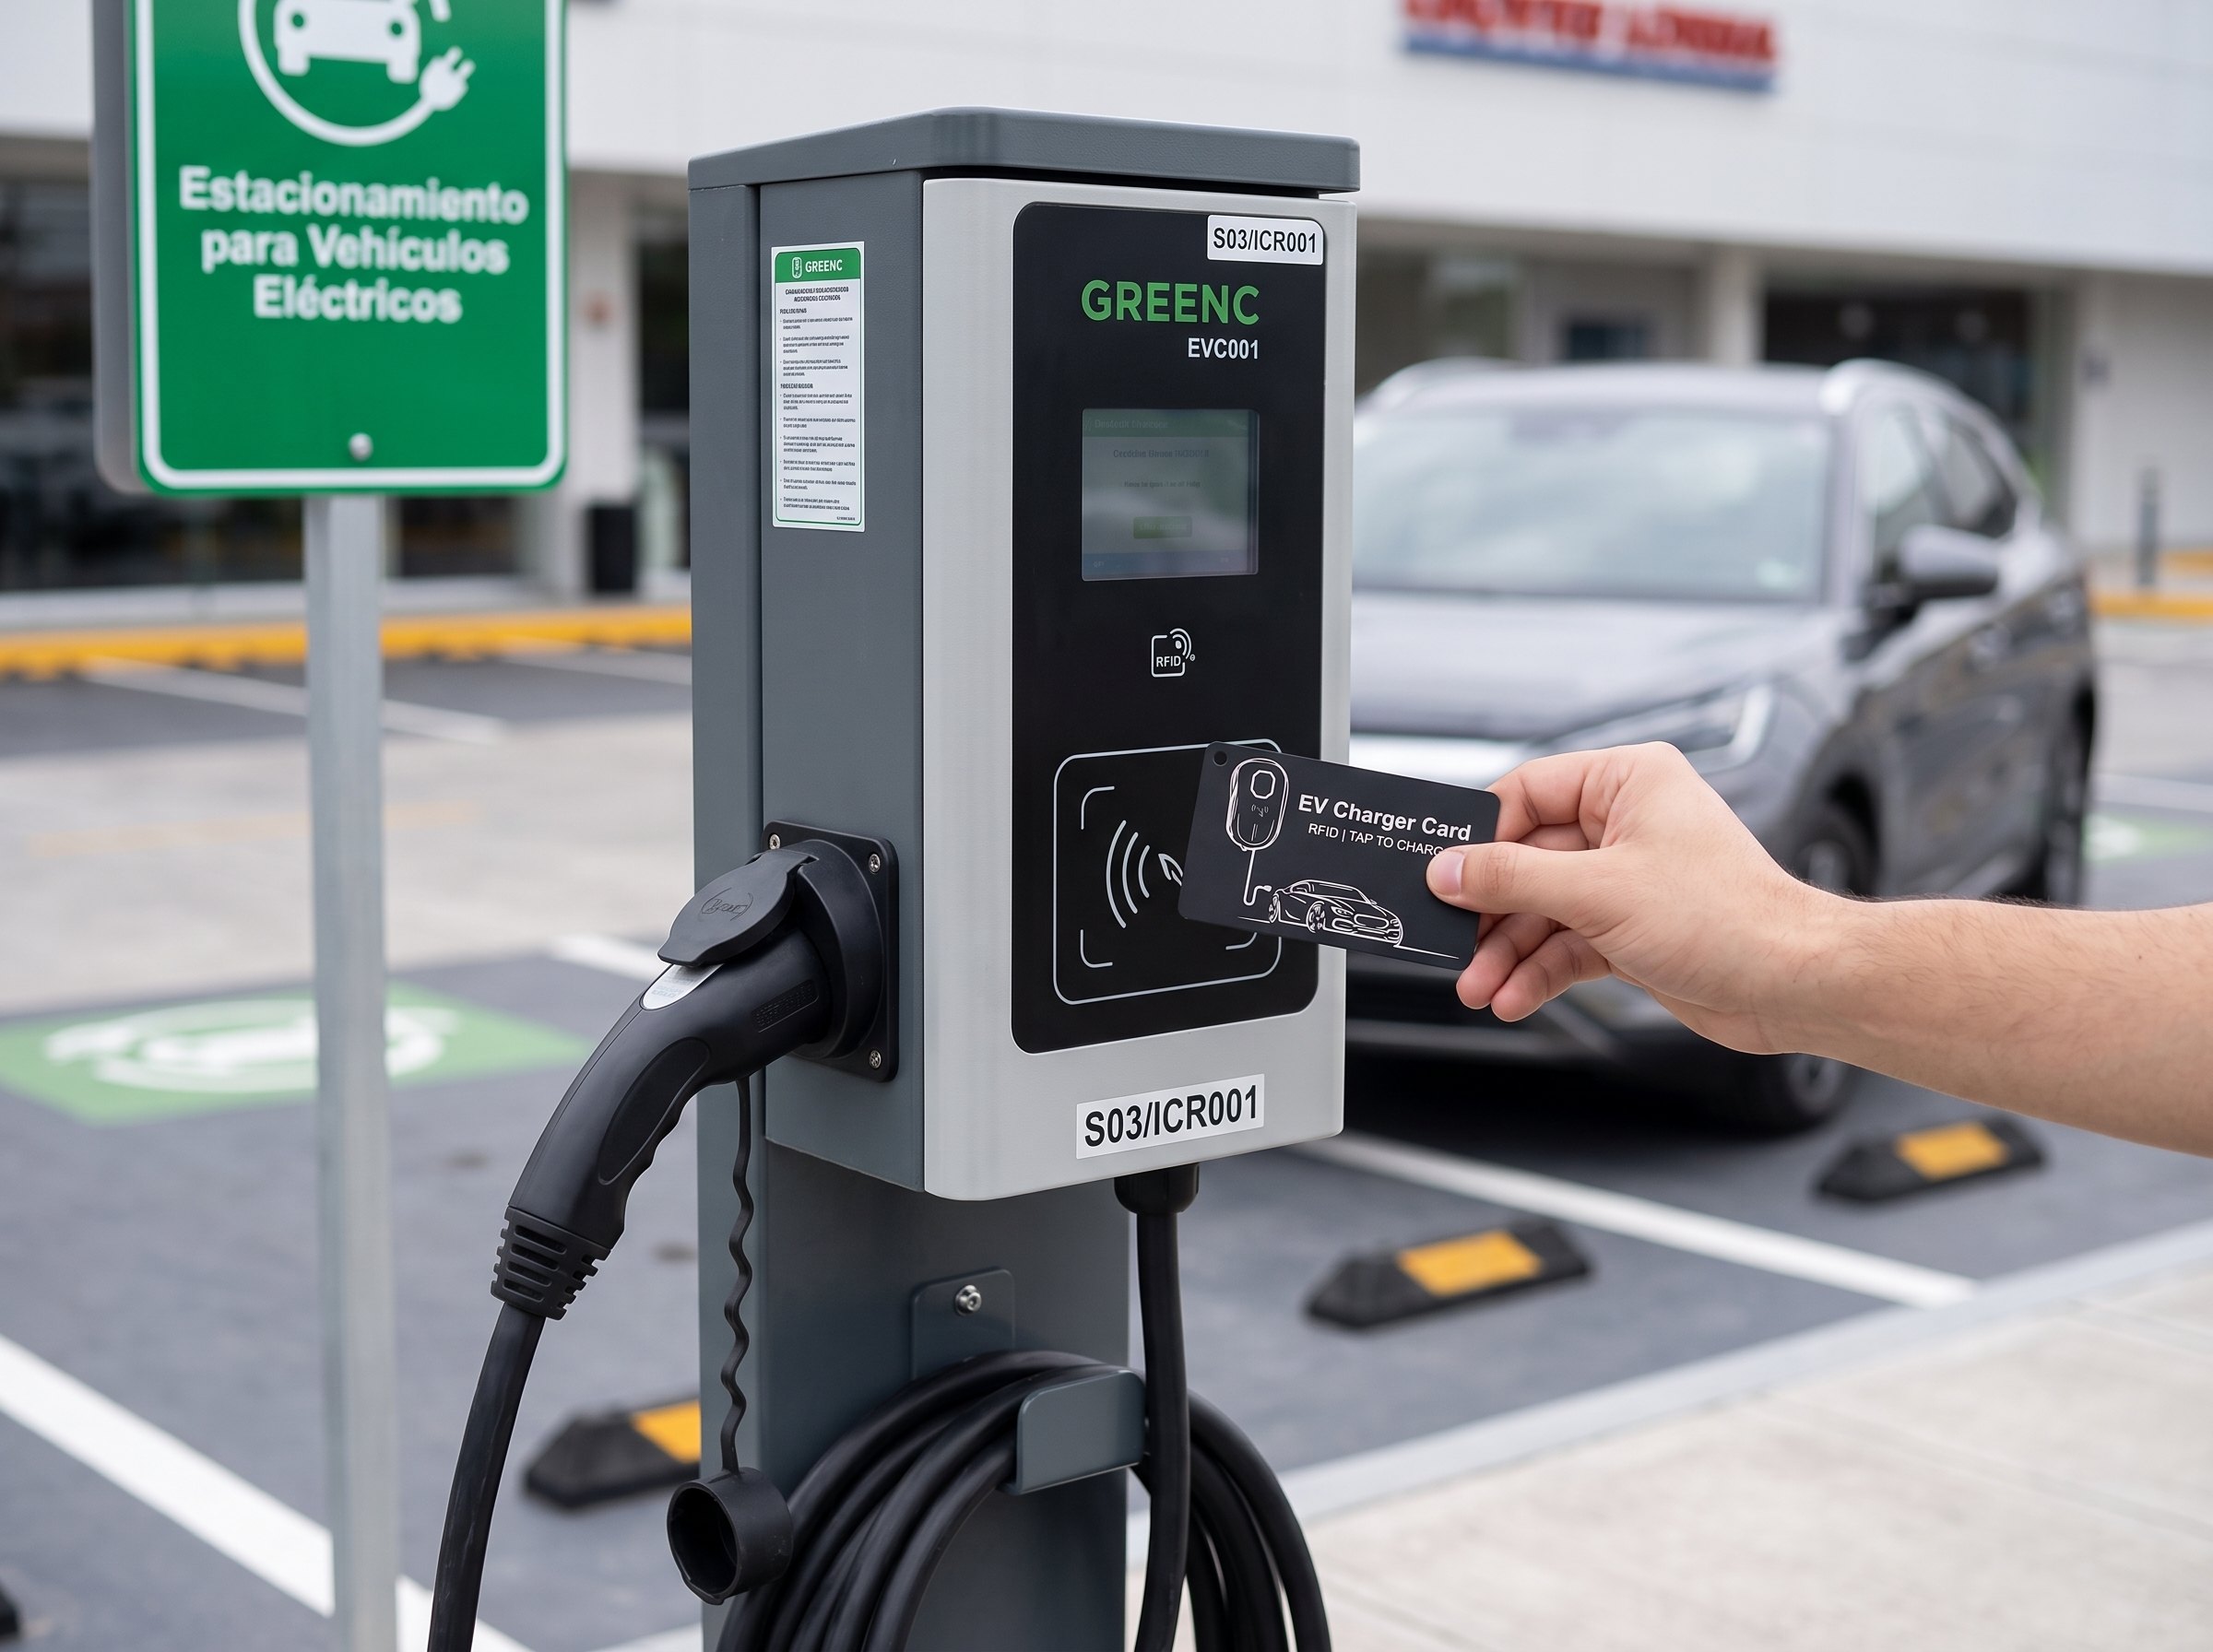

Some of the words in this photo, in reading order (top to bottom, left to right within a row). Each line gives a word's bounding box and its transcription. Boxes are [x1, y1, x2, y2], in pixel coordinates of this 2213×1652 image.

[179, 165, 529, 225] Estacionamiento
[201, 229, 300, 275] para
[306, 222, 511, 275] Vehículos
[1213, 227, 1317, 254] S03/ICR001
[805, 259, 843, 273] GREENC
[254, 273, 463, 324] Eléctricos
[1082, 279, 1260, 325] GREENC
[1188, 337, 1259, 360] EVC001
[1155, 655, 1181, 667] RFID
[1298, 794, 1329, 814] EV
[1333, 801, 1416, 832] Charger
[1422, 817, 1472, 842] Card
[1308, 822, 1339, 838] RFID
[1349, 830, 1374, 844] TAP
[1377, 835, 1393, 848] TO
[1396, 839, 1444, 856] CHARG
[1084, 1084, 1256, 1148] S03/ICR001
